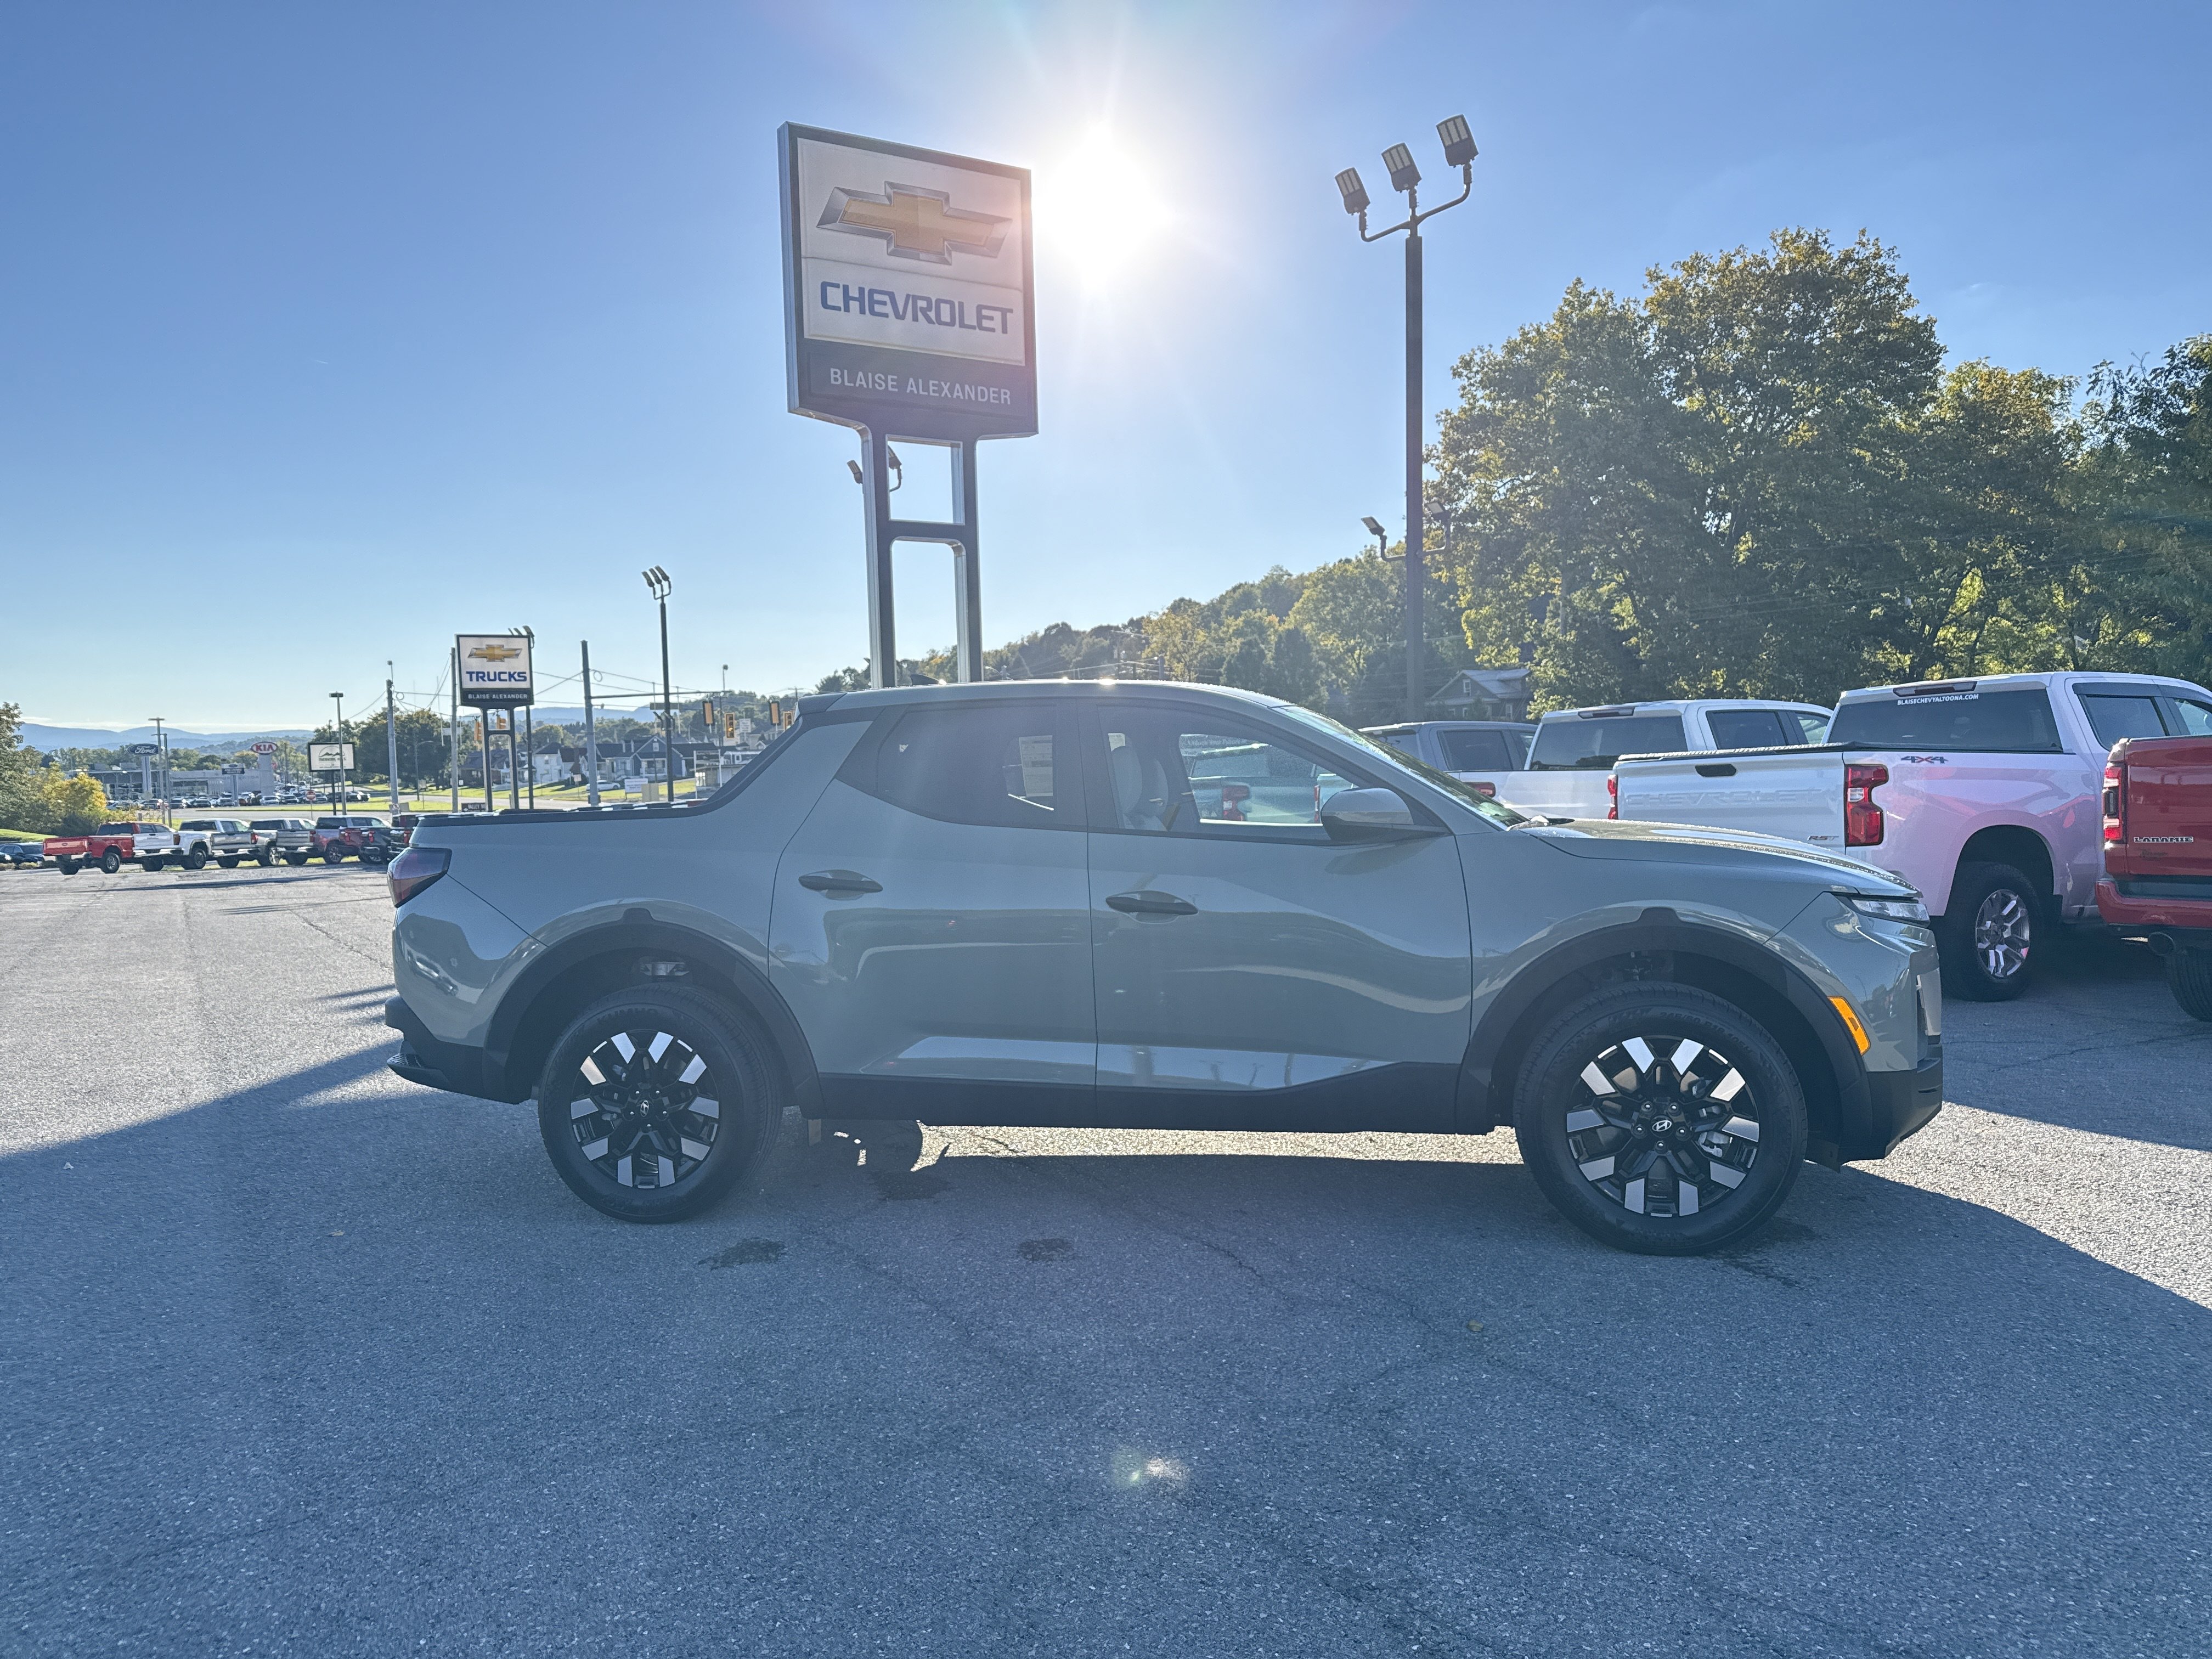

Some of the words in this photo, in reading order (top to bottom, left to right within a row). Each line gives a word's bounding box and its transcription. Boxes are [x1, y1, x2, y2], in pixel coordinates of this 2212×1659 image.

[820, 281, 1013, 334] CHEVROLET
[830, 368, 898, 392] BLAISE
[906, 377, 1011, 405] ALEXANDER
[466, 671, 527, 682] TRUCKS
[1897, 694, 1979, 706] BLAISECHEVYALTOONA.COM
[134, 745, 156, 754] Ford
[1627, 789, 1821, 806] CHEVROLET
